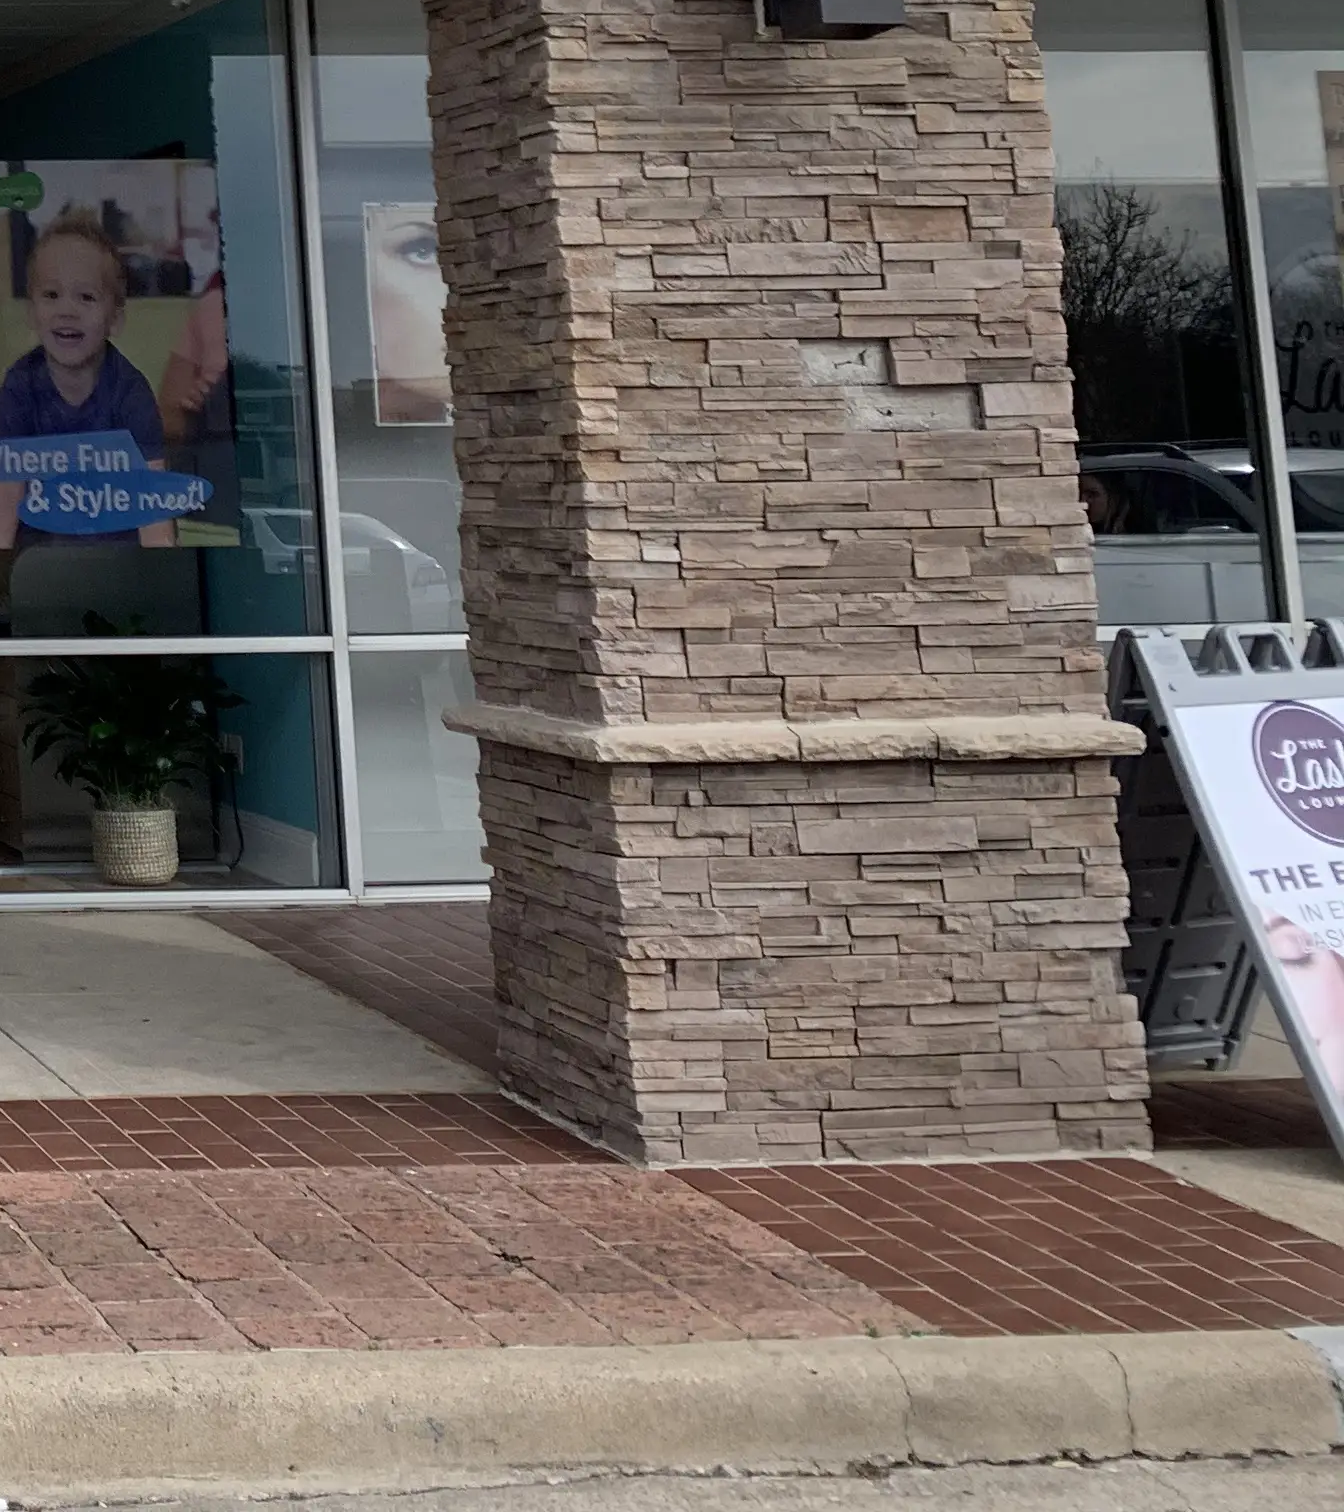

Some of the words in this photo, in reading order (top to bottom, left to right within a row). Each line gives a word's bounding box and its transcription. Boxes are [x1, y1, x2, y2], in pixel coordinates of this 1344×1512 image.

[78, 445, 131, 475] Fun
[26, 479, 51, 514] &
[58, 482, 132, 519] Style
[138, 480, 206, 512] meet!
[1296, 738, 1328, 750] THE
[1248, 863, 1324, 895] THE
[1298, 902, 1325, 923] IN
